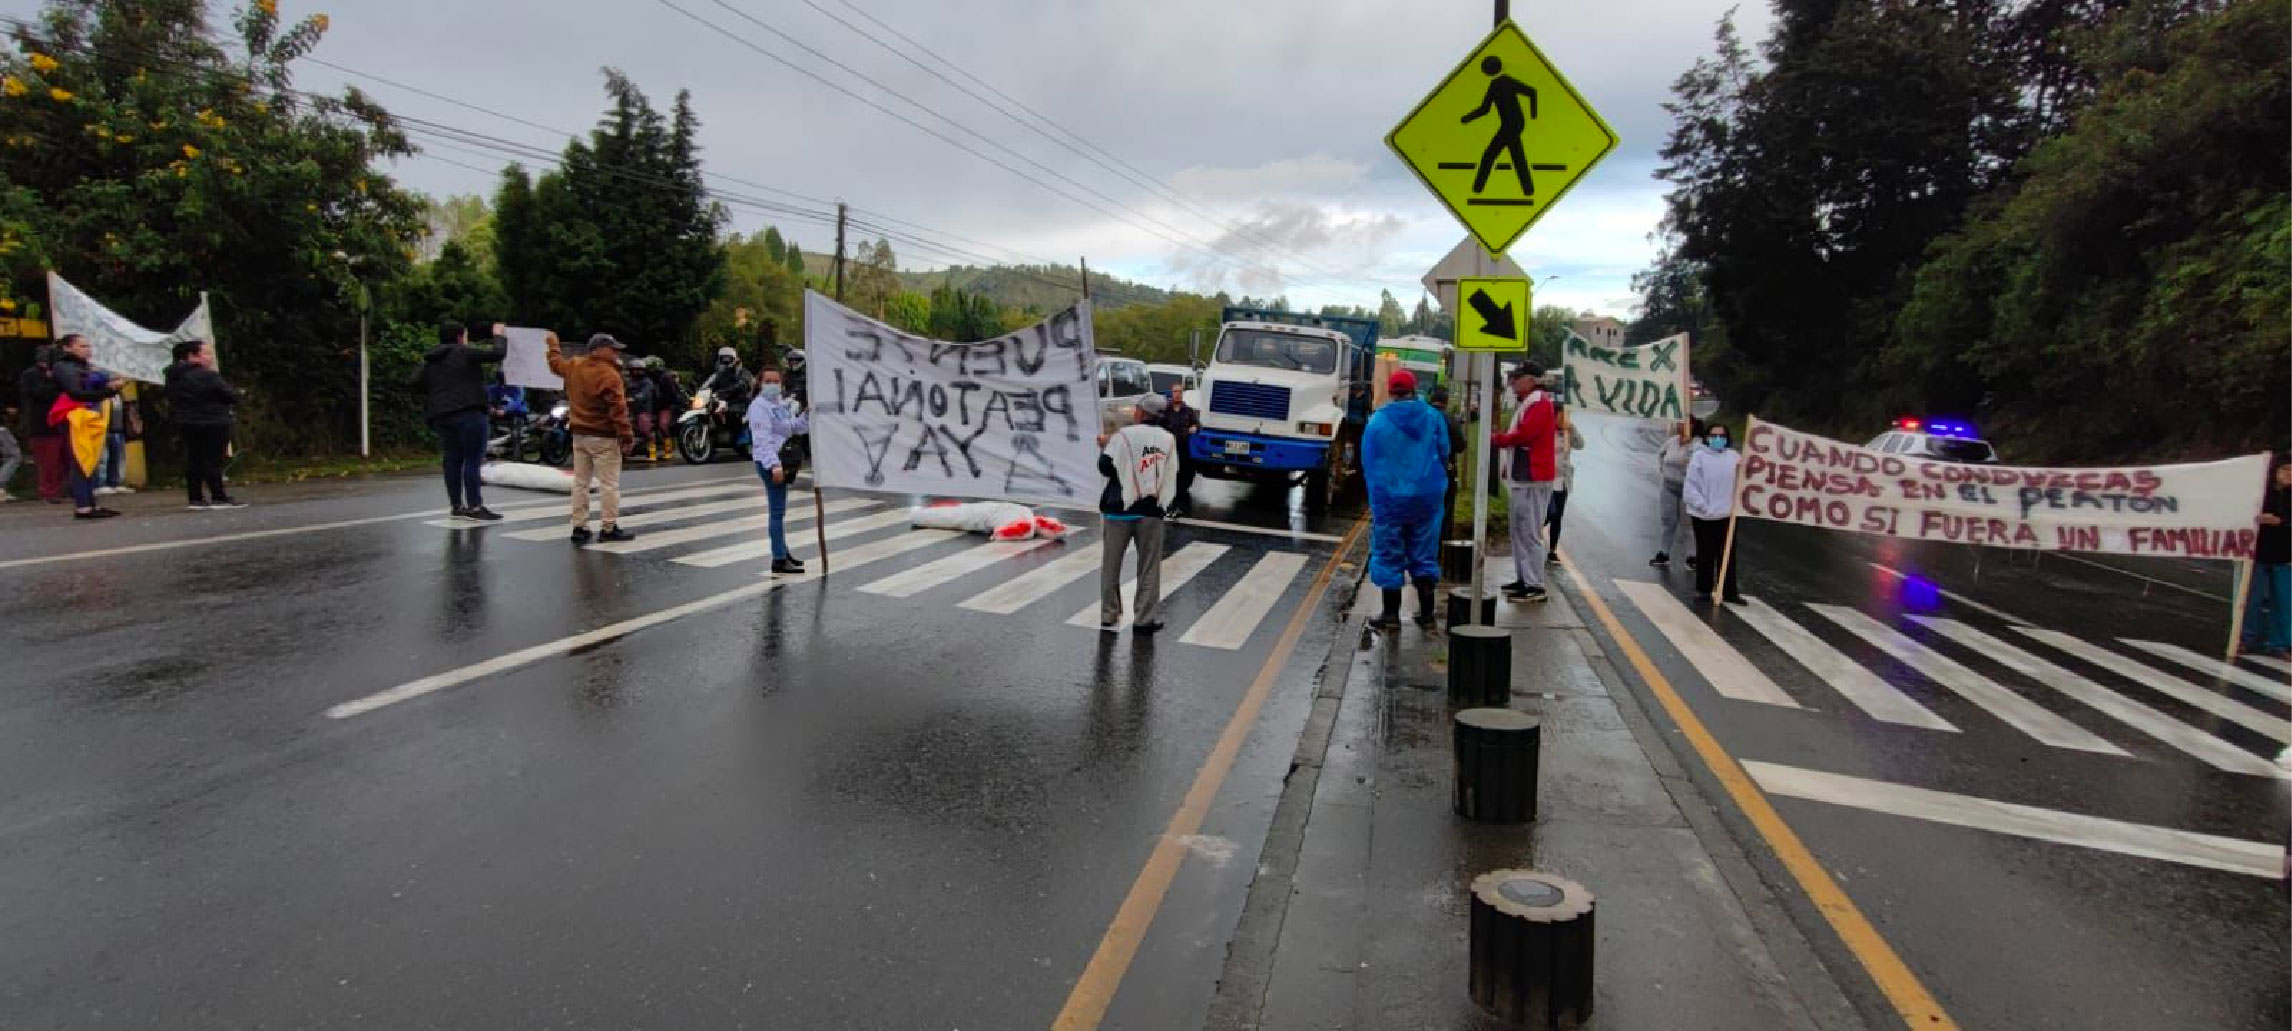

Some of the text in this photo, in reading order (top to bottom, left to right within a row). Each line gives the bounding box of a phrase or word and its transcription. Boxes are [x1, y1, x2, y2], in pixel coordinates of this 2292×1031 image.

[1650, 340, 1678, 372] X
[1594, 374, 1682, 418] VIDA
[1749, 425, 1906, 476] CUANDO
[1744, 454, 2179, 520] PIENSA EN EL PEATON
[1741, 483, 2256, 559] COMO SI FUERA UN FAMILIAR
